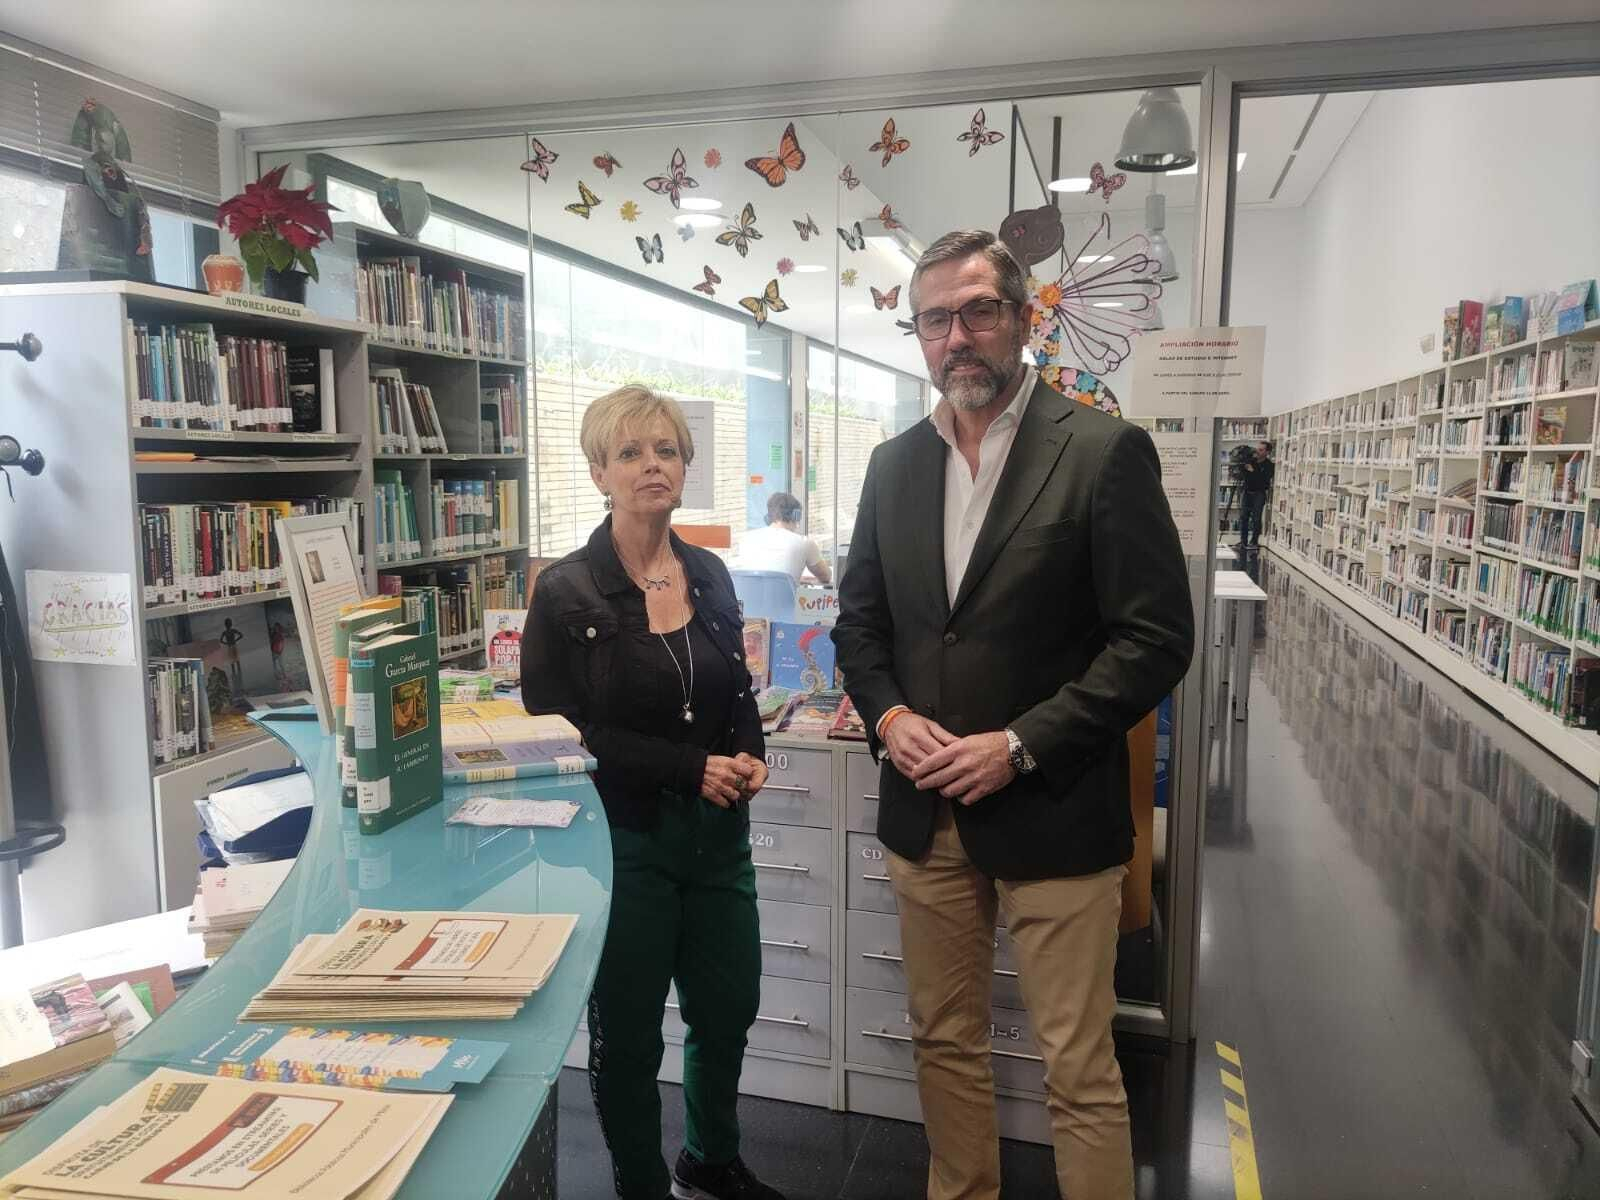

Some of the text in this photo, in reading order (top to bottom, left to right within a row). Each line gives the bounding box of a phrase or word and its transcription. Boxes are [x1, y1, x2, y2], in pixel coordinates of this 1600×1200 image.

[225, 296, 301, 317] AUTORES LOCALES
[55, 1114, 157, 1178] LA CULTURA
